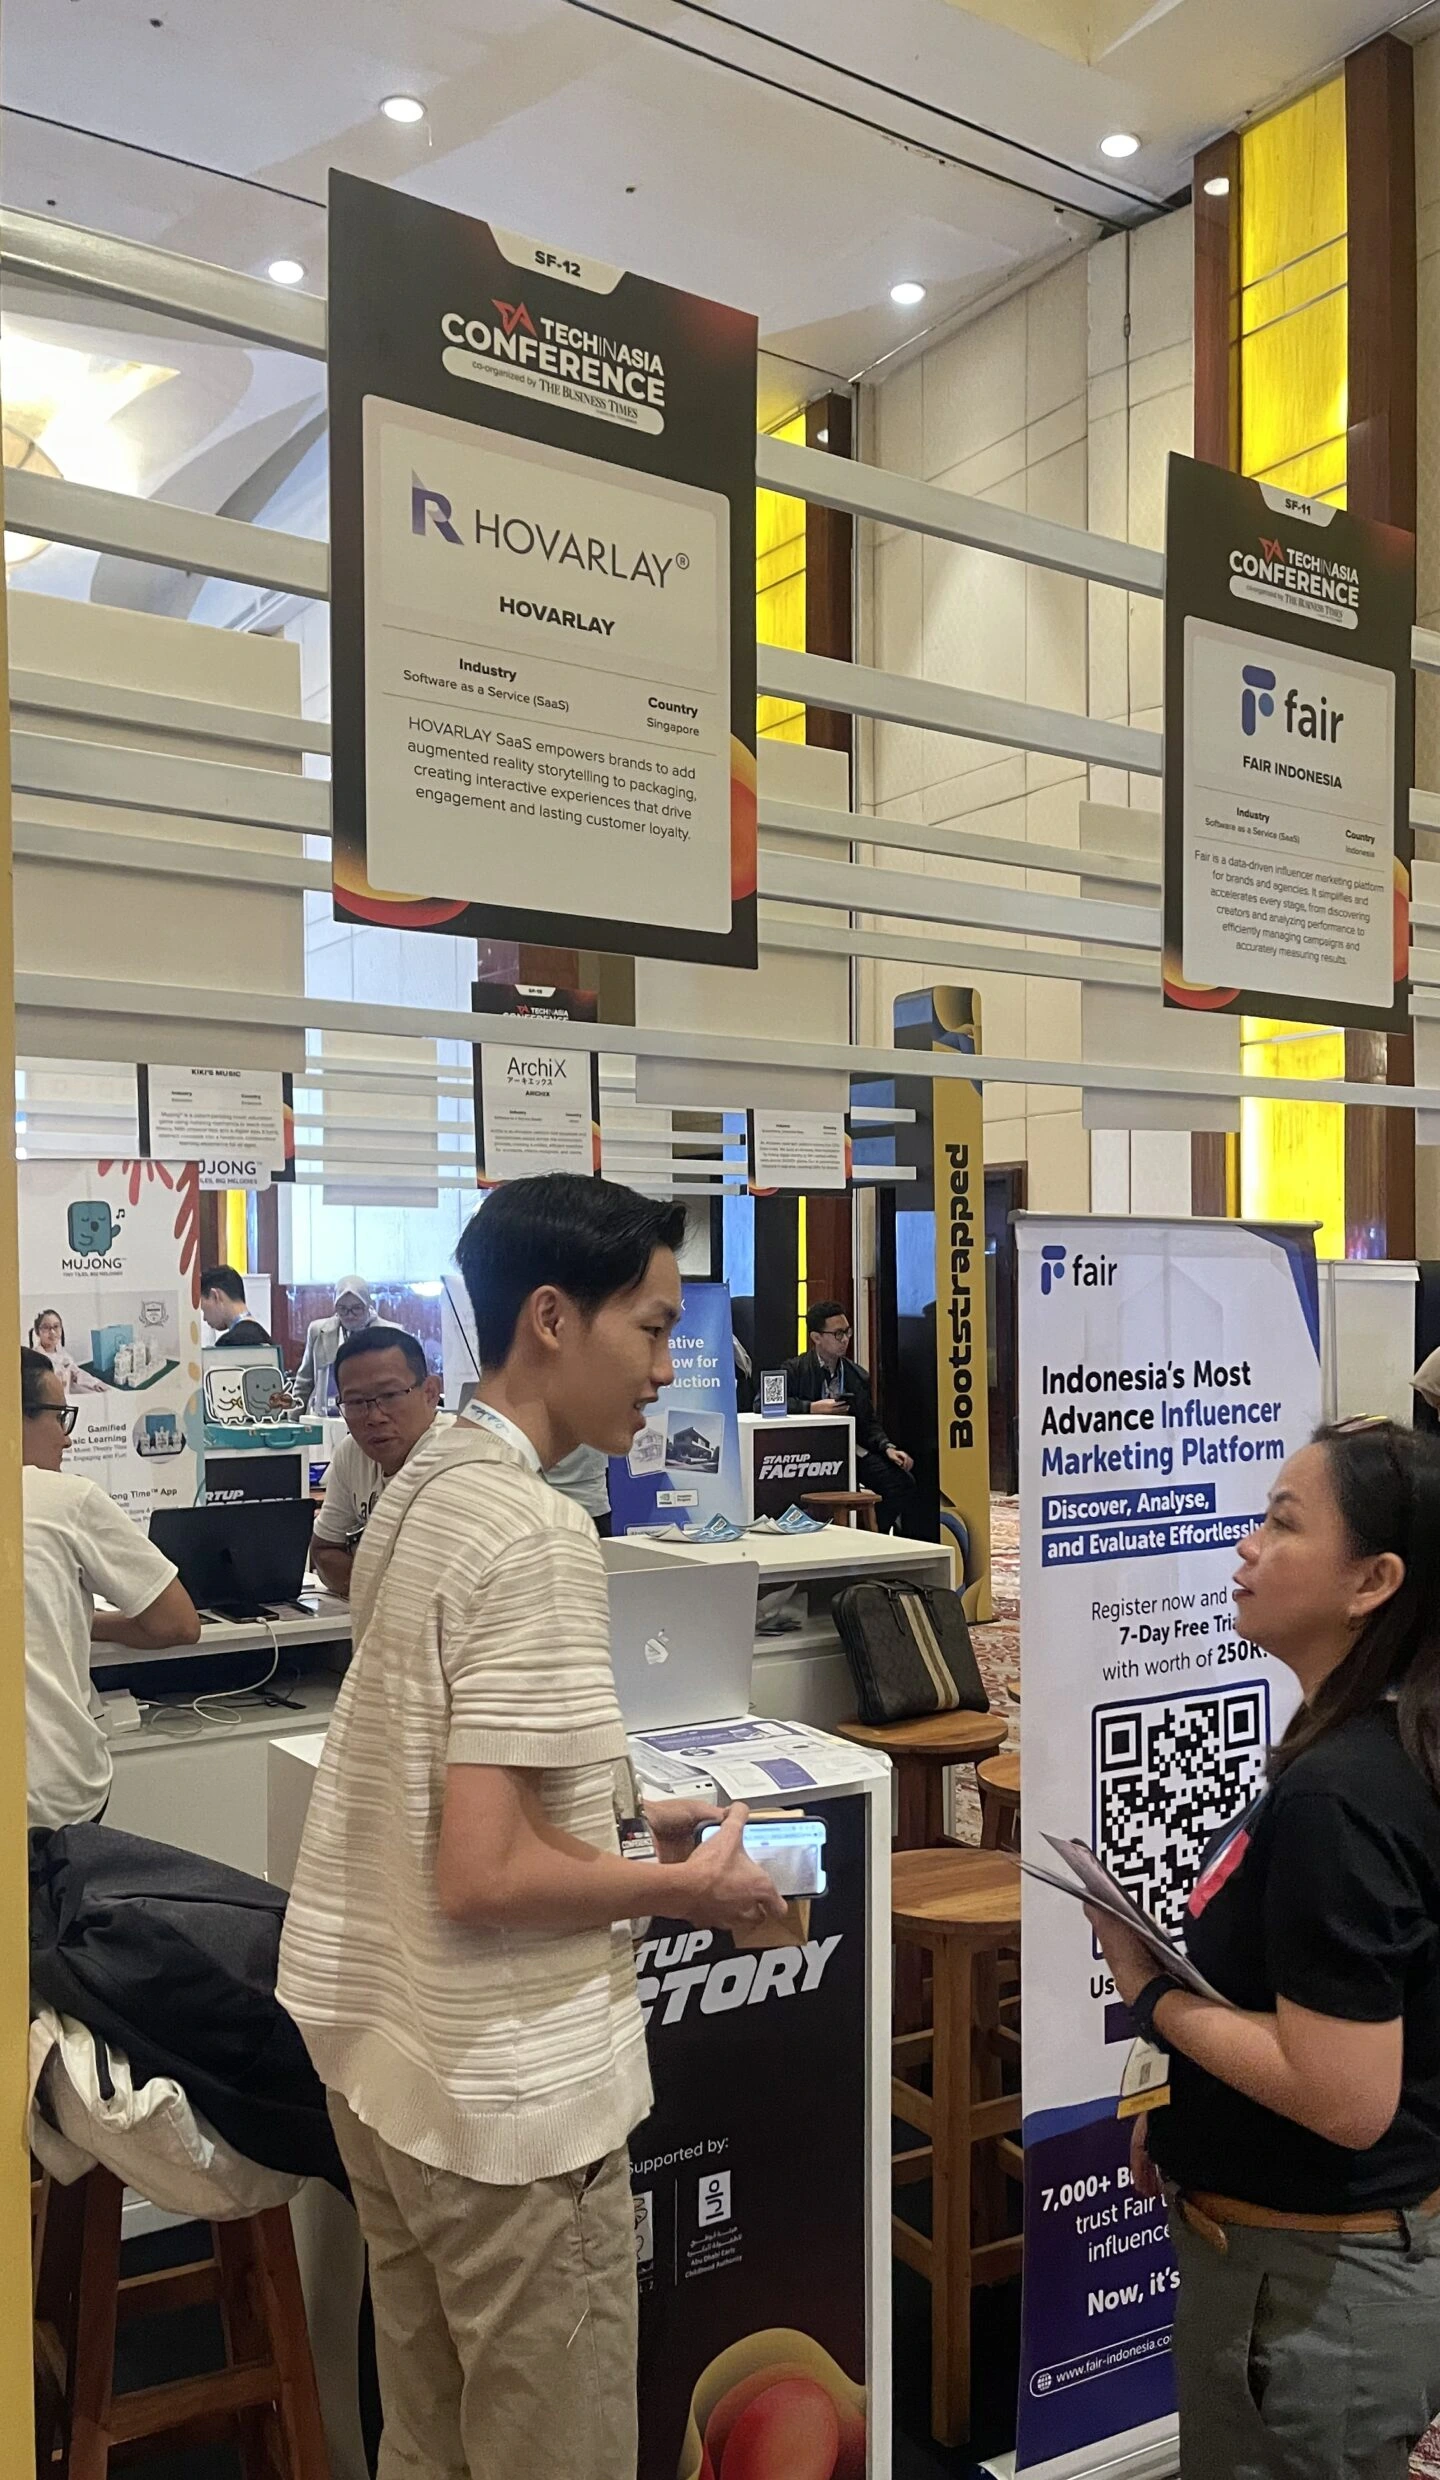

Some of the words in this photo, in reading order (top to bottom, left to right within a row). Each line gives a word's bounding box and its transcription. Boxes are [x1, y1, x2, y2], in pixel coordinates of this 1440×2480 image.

[535, 250, 580, 277] SF-12
[441, 313, 665, 407] CONFERENCE
[540, 317, 664, 376] TECHINASIA
[472, 361, 525, 384] co-organized
[527, 374, 537, 388] by
[539, 378, 560, 396] THE
[563, 385, 606, 410] BUSINESS
[608, 400, 638, 419] TIMES
[1285, 498, 1311, 516] SF-11
[1229, 550, 1359, 608] CONFERENCE
[500, 596, 616, 636] HOVARLAY
[459, 659, 517, 682] Industry
[403, 670, 457, 691] Software
[461, 681, 474, 694] as
[477, 685, 485, 696] a
[488, 686, 530, 706] Service
[533, 694, 569, 713] (SaaS)
[648, 697, 698, 718] Country
[646, 717, 699, 738] Singapore
[1284, 688, 1345, 743] fair
[408, 716, 492, 744] HOVARLAY
[496, 732, 532, 751] SaaS
[536, 741, 605, 766] empowers
[609, 753, 652, 774] brands
[656, 762, 668, 776] to
[672, 763, 696, 780] add
[407, 740, 488, 766] augmented
[493, 754, 534, 775] reality
[538, 762, 609, 788] storytelling
[613, 775, 625, 789] to
[630, 778, 697, 803] packaging,
[1243, 755, 1271, 774] FAIR
[1274, 764, 1343, 790] INDONESIA
[414, 764, 471, 787] creating
[476, 772, 547, 796] interactive
[550, 783, 630, 811] experiences
[634, 798, 658, 815] that
[661, 803, 692, 820] drive
[415, 786, 506, 812] engagement
[509, 799, 535, 816] and
[539, 804, 582, 826] lasting
[586, 813, 645, 834] customer
[649, 822, 691, 843] loyalty.
[1205, 817, 1236, 831] Software
[1253, 827, 1277, 839] Service
[1236, 807, 1270, 824] Industry
[1345, 829, 1375, 845] Country
[1194, 850, 1210, 861] Fair
[1212, 855, 1219, 863] is
[1228, 857, 1274, 873] data-driven
[1275, 865, 1313, 880] influencer
[1315, 874, 1352, 889] marketing
[1354, 881, 1384, 893] platform
[1212, 870, 1224, 880] for
[1226, 872, 1254, 887] brands
[1256, 880, 1271, 889] and
[1273, 882, 1309, 896] agencies.
[1318, 889, 1352, 903] simplifies
[1354, 896, 1368, 906] and
[1210, 888, 1257, 903] accelerates
[1259, 896, 1281, 909] every
[1283, 900, 1307, 912] stage,
[1308, 902, 1326, 914] from
[1328, 907, 1370, 924] discovering
[1216, 906, 1250, 918] creators
[1252, 911, 1267, 921] and
[1269, 914, 1305, 929] analyzing
[1307, 920, 1355, 935] performance
[1357, 927, 1365, 936] to
[1222, 922, 1261, 938] efficiently
[1262, 929, 1301, 944] managing
[1303, 935, 1344, 949] campaigns
[1345, 942, 1360, 951] and
[1236, 942, 1277, 957] accurately
[1279, 948, 1319, 963] measuring
[507, 1057, 567, 1078] ArchiX
[1072, 1254, 1117, 1287] fair
[945, 1143, 974, 1450] Bootstrapped
[672, 1358, 694, 1369] ow
[697, 1355, 719, 1368] for
[1042, 1360, 1185, 1395] Indonesia's
[1193, 1360, 1251, 1388] Most
[672, 1374, 720, 1388] uction
[87, 1424, 126, 1433] Gamified
[1041, 1405, 1155, 1436] Advance
[1161, 1399, 1282, 1429] Influencer
[88, 1435, 127, 1444] Learning
[758, 1460, 843, 1481] FACTORY
[763, 1453, 811, 1464] STARTUP
[1041, 1441, 1173, 1477] Marketing
[1182, 1435, 1285, 1467] Platform
[160, 1488, 177, 1497] App
[1048, 1496, 1132, 1522] Discover,
[1137, 1490, 1210, 1515] Analyse,
[1047, 1536, 1084, 1559] and
[1089, 1529, 1166, 1554] Evaluate
[1091, 1597, 1157, 1621] Register
[1161, 1595, 1195, 1613] now
[1200, 1586, 1227, 1606] and
[1119, 1624, 1170, 1646] 7-Day
[1174, 1619, 1209, 1639] Free
[1102, 1659, 1139, 1681] with
[1144, 1653, 1191, 1677] worth
[1196, 1649, 1214, 1669] of
[1090, 1974, 1115, 1999] Us
[707, 2137, 729, 2154] by:
[1041, 2175, 1111, 2213] 7,000+
[1076, 2204, 1118, 2235] trust
[1124, 2195, 1156, 2220] Fair
[1087, 2282, 1144, 2317] Now,
[1150, 2266, 1181, 2297] it's
